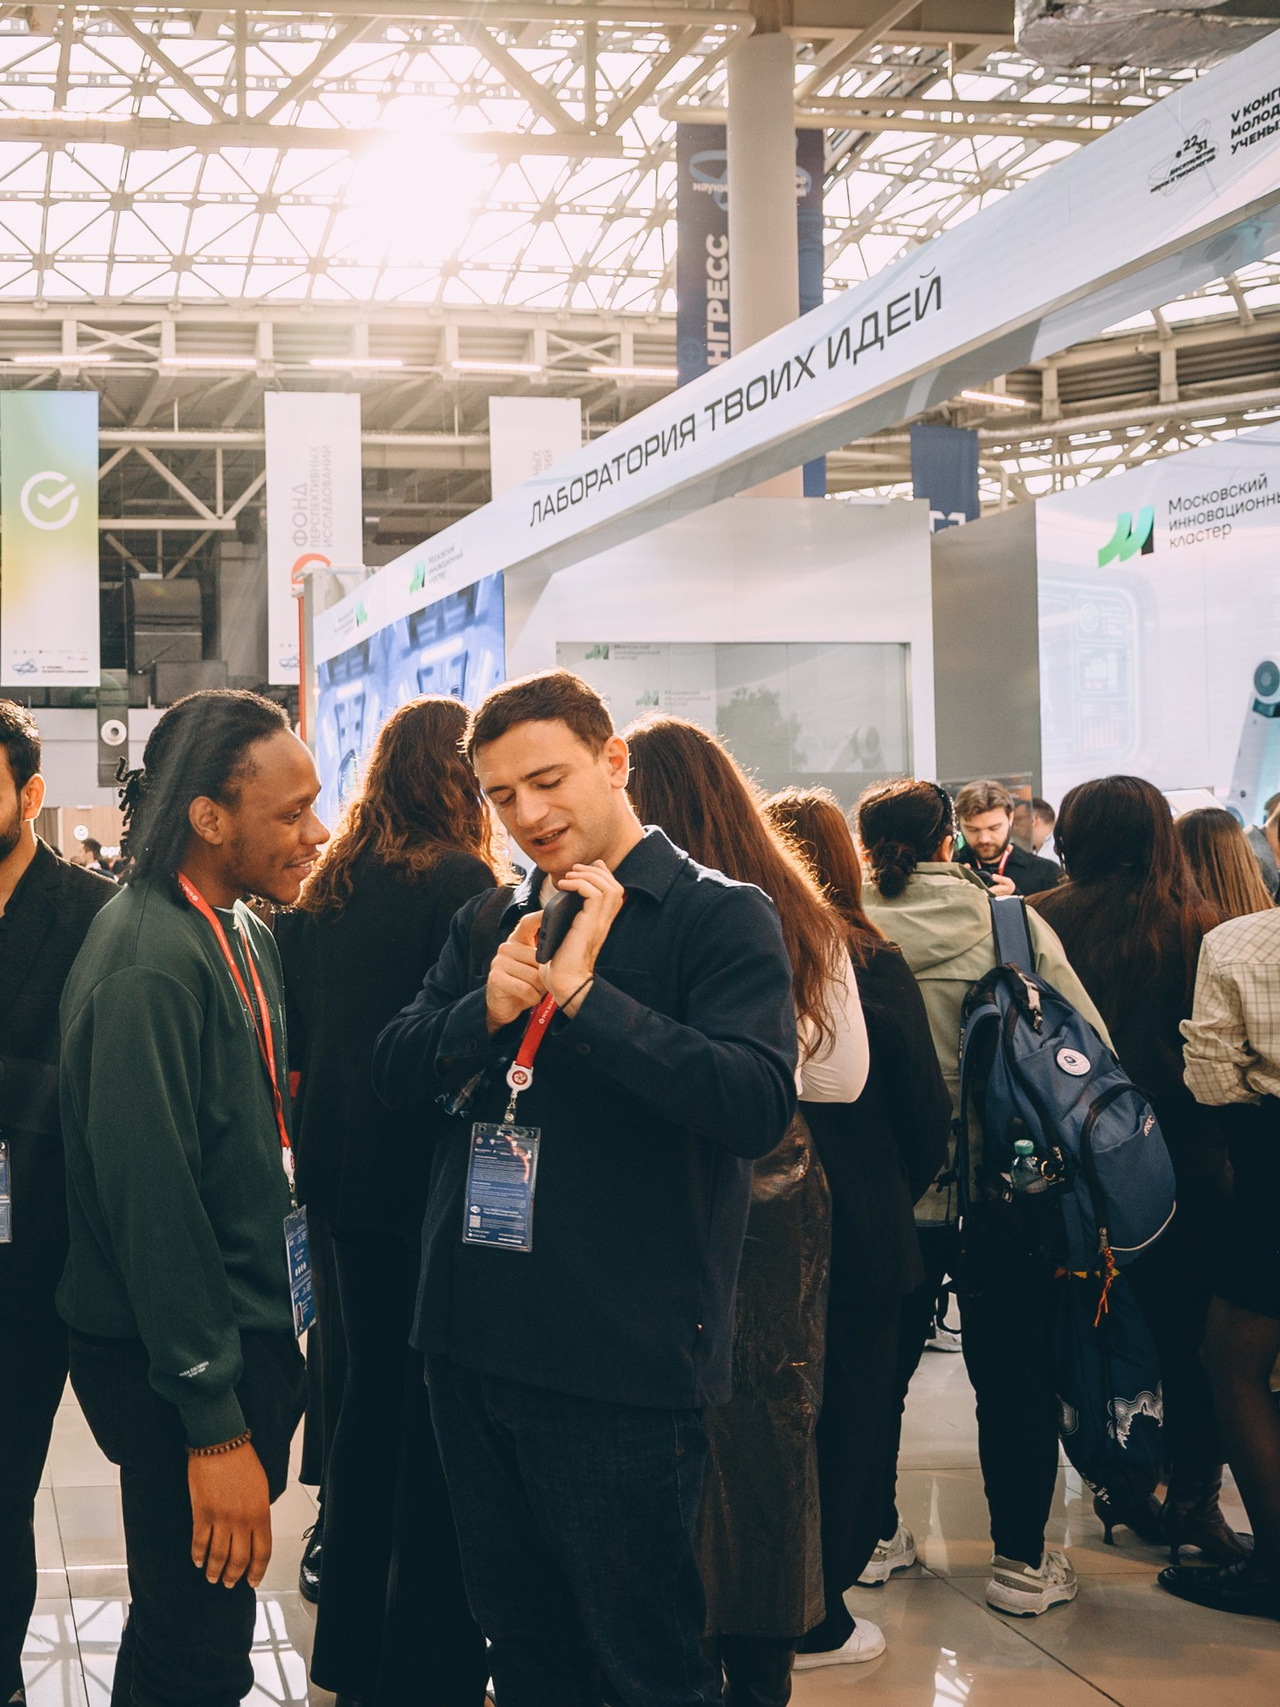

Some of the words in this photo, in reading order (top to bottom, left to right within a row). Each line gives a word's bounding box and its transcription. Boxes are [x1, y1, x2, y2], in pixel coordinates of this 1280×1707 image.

[1231, 109, 1240, 122] V
[1231, 103, 1280, 139] МОЛОД
[1231, 119, 1280, 155] УЧЕНЫ
[529, 412, 697, 528] ЛАБОРАТОРИЯ
[704, 351, 817, 433] ТВОИХ
[827, 266, 943, 369] ИДЕЙ
[310, 445, 320, 548] ПЕРСПЕКТИВНЫХ
[1168, 472, 1268, 514] Московский
[291, 482, 308, 547] ФОНД
[1169, 521, 1232, 549] кластер
